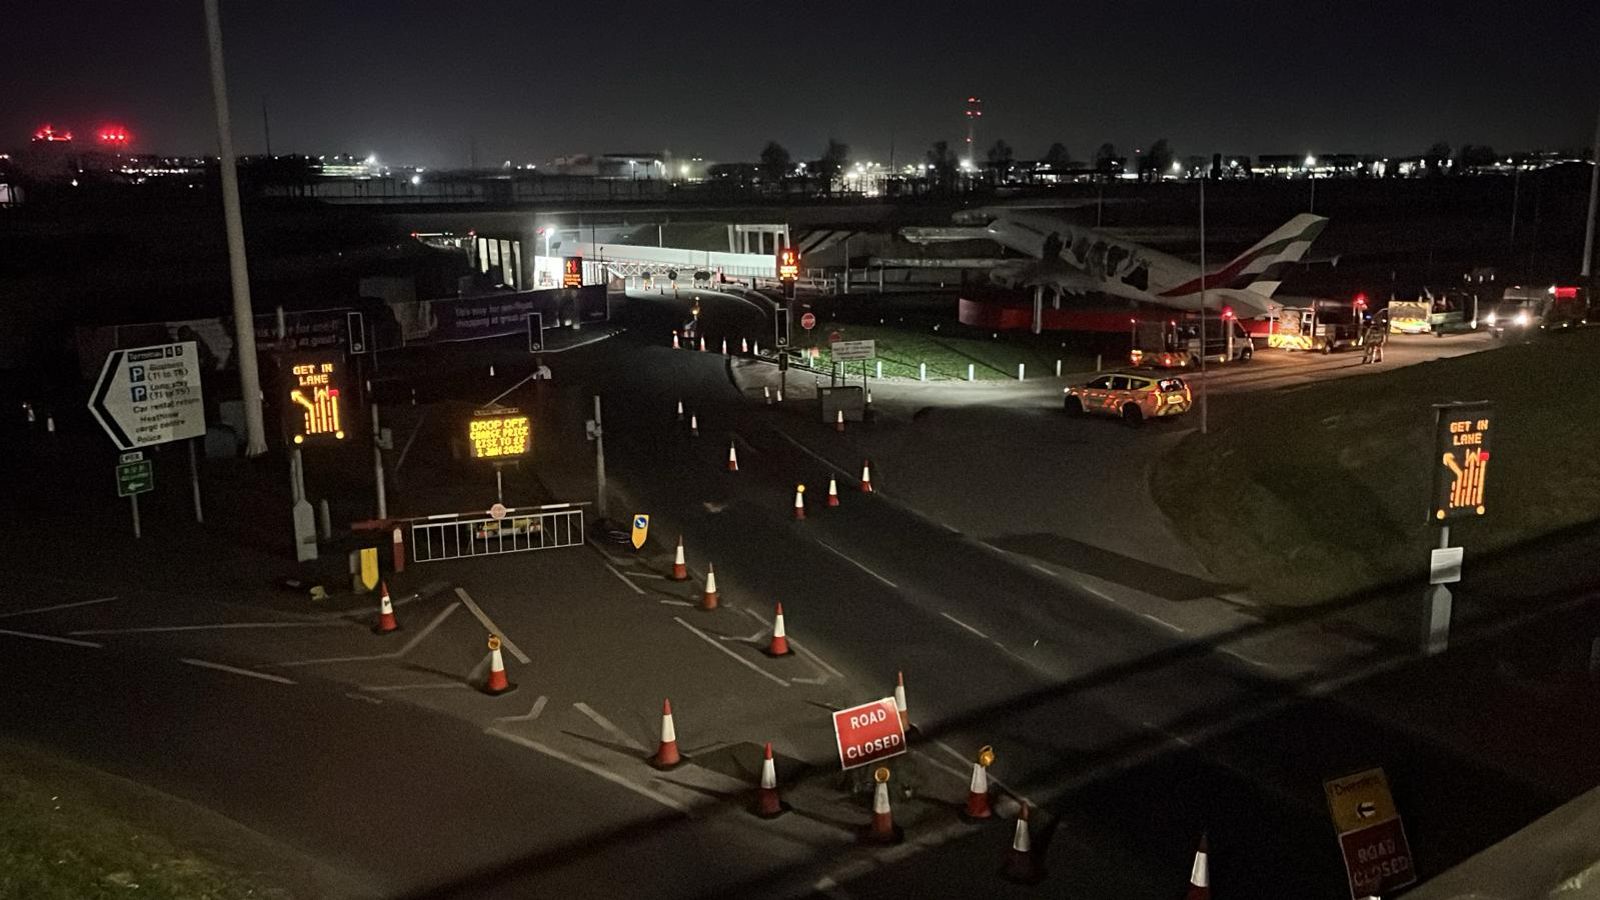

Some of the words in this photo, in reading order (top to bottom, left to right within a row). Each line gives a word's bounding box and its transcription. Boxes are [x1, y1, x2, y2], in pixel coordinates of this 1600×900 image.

[292, 364, 315, 375] GET
[321, 363, 333, 373] IN
[299, 374, 329, 386] LANE
[151, 400, 175, 410] rental
[470, 420, 502, 432] DROP
[503, 417, 527, 429] OFF
[1450, 420, 1472, 433] GET
[1477, 419, 1489, 430] IN
[470, 429, 502, 440] CHARGE
[503, 426, 529, 437] PRICE
[1453, 432, 1483, 446] LANE
[476, 438, 498, 449] RISE
[500, 437, 512, 447] TO
[850, 709, 887, 730] ROAD
[846, 734, 900, 759] CLOSED
[1357, 839, 1396, 864] ROAD
[1353, 856, 1409, 887] CLOSED
